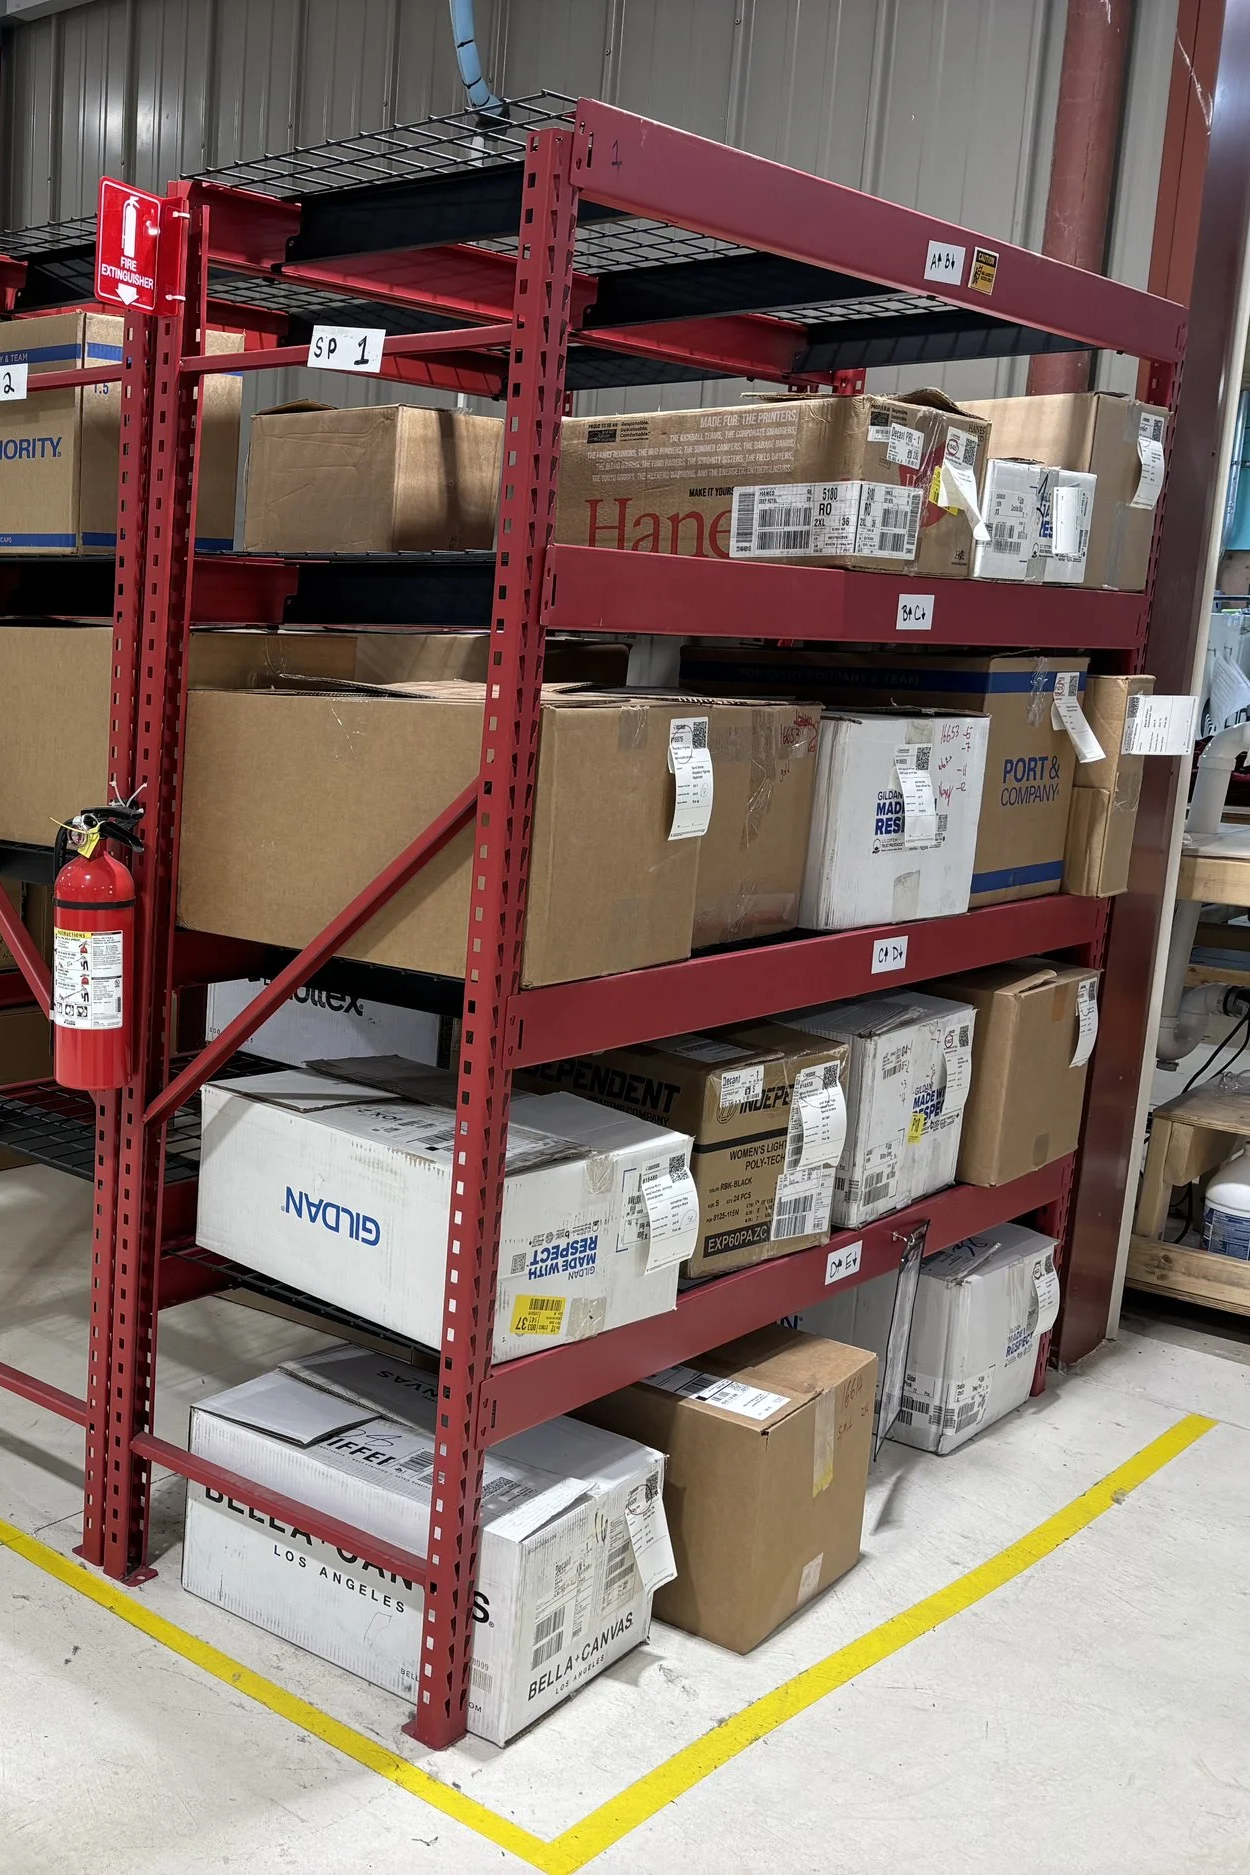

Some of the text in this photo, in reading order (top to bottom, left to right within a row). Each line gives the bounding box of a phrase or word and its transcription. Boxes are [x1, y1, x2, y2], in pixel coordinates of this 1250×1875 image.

[120, 256, 137, 272] FIRE
[101, 263, 154, 290] EXTINGUISHER
[4, 355, 10, 363] &
[10, 353, 28, 362] TEAM
[313, 335, 370, 366] SP 1
[3, 371, 16, 394] 2
[700, 416, 723, 428] MADE
[723, 414, 739, 426] FOR:
[742, 413, 757, 425] THE
[689, 487, 707, 497] MAKE
[707, 487, 714, 496] IT
[822, 488, 838, 501] 5180
[818, 503, 832, 516] RO
[586, 498, 733, 559] Hane
[814, 517, 850, 527] 2XL 36
[1002, 755, 1060, 784] PORT &
[1000, 782, 1059, 807] COMPANY
[912, 1090, 935, 1110] MADE
[730, 1144, 766, 1161] WOMEN'S
[733, 1194, 740, 1202] 24
[740, 1191, 752, 1201] PCS
[284, 1184, 381, 1248] GILDAN
[707, 1225, 768, 1253] EXP60PAZC
[529, 1235, 599, 1267] RESPECT
[528, 1252, 597, 1280] MADE WITH
[567, 1265, 596, 1280] GILDAN
[515, 1316, 528, 1331] 37
[273, 1544, 407, 1614] LOS ANGELES
[528, 1611, 634, 1701] BELLA+CANVAS
[555, 1654, 605, 1695] LOS ANGELES
